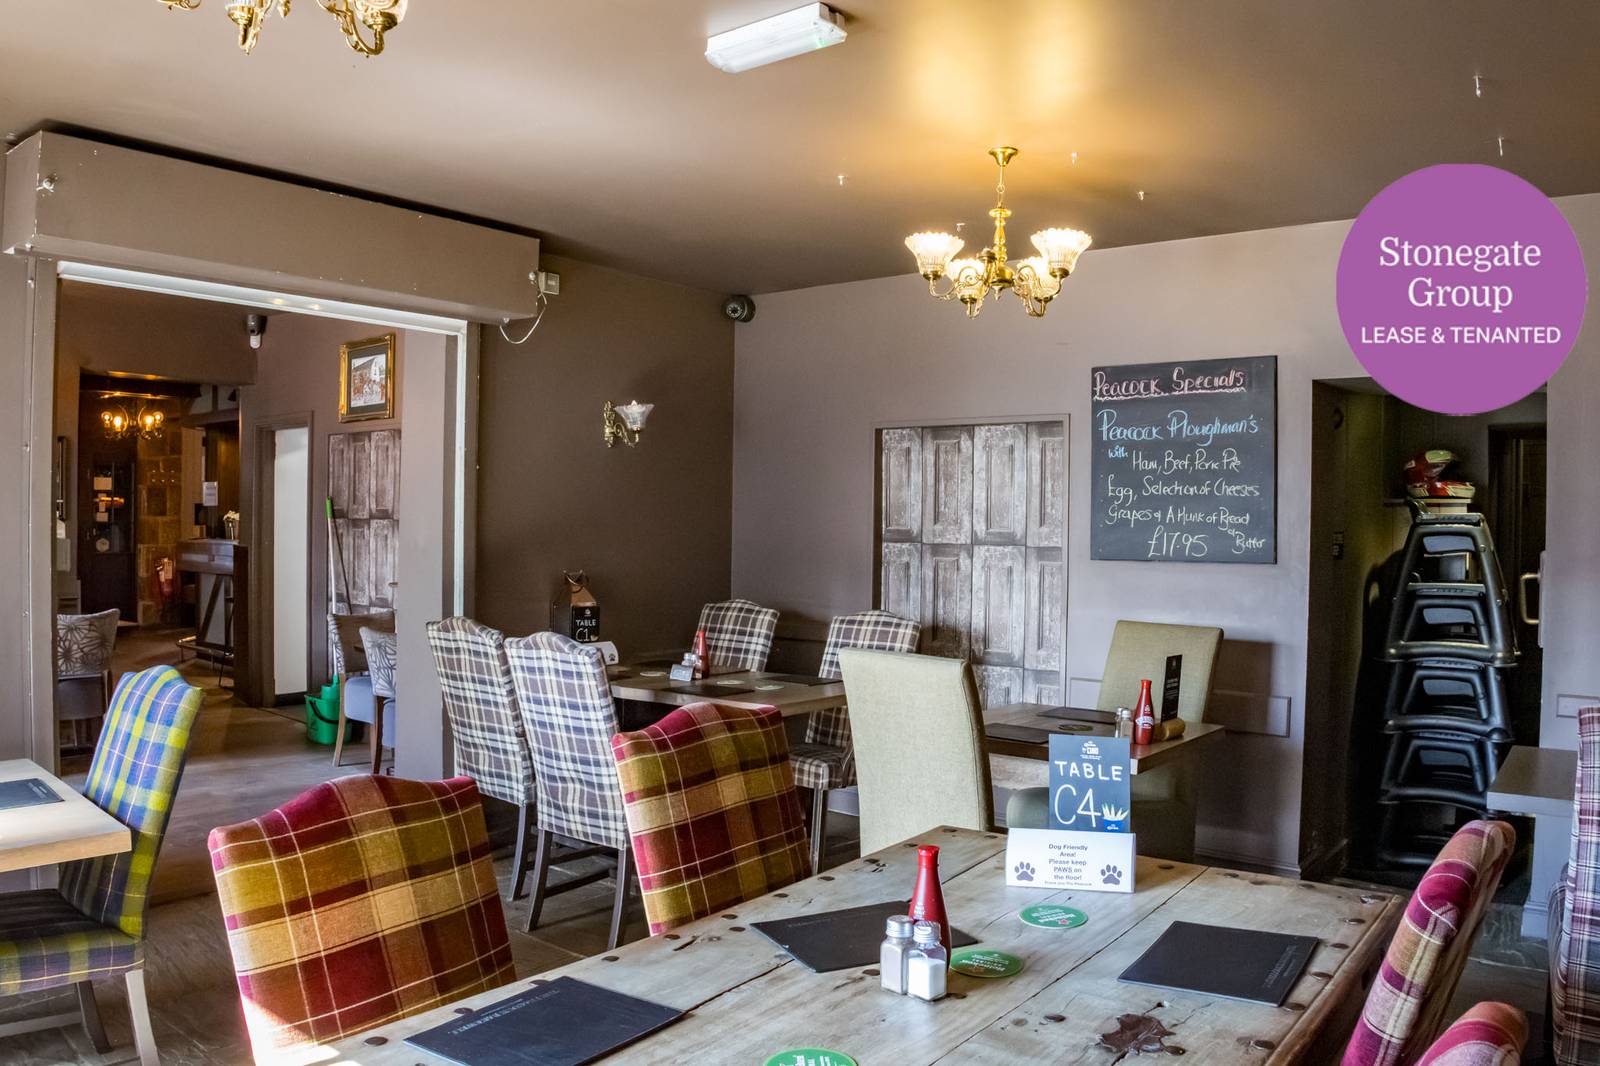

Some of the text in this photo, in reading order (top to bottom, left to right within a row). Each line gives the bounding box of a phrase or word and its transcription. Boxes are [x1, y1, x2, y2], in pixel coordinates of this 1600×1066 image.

[1093, 367, 1244, 396] Peacock Specials
[1096, 409, 1258, 447] Peacock Ploughman's
[1108, 444, 1128, 458] with
[1107, 474, 1260, 507] Egg, Selection of Cheeses
[1105, 504, 1152, 528] Grapes
[1166, 506, 1175, 524] A
[1205, 512, 1218, 525] of
[1218, 506, 1250, 531] Bread
[1147, 525, 1209, 558] £17.95
[575, 628, 590, 641] C1
[1054, 760, 1123, 782] TABLE
[1054, 784, 1102, 828] C4
[1053, 866, 1073, 874] PAWS
[1071, 859, 1088, 867] keep
